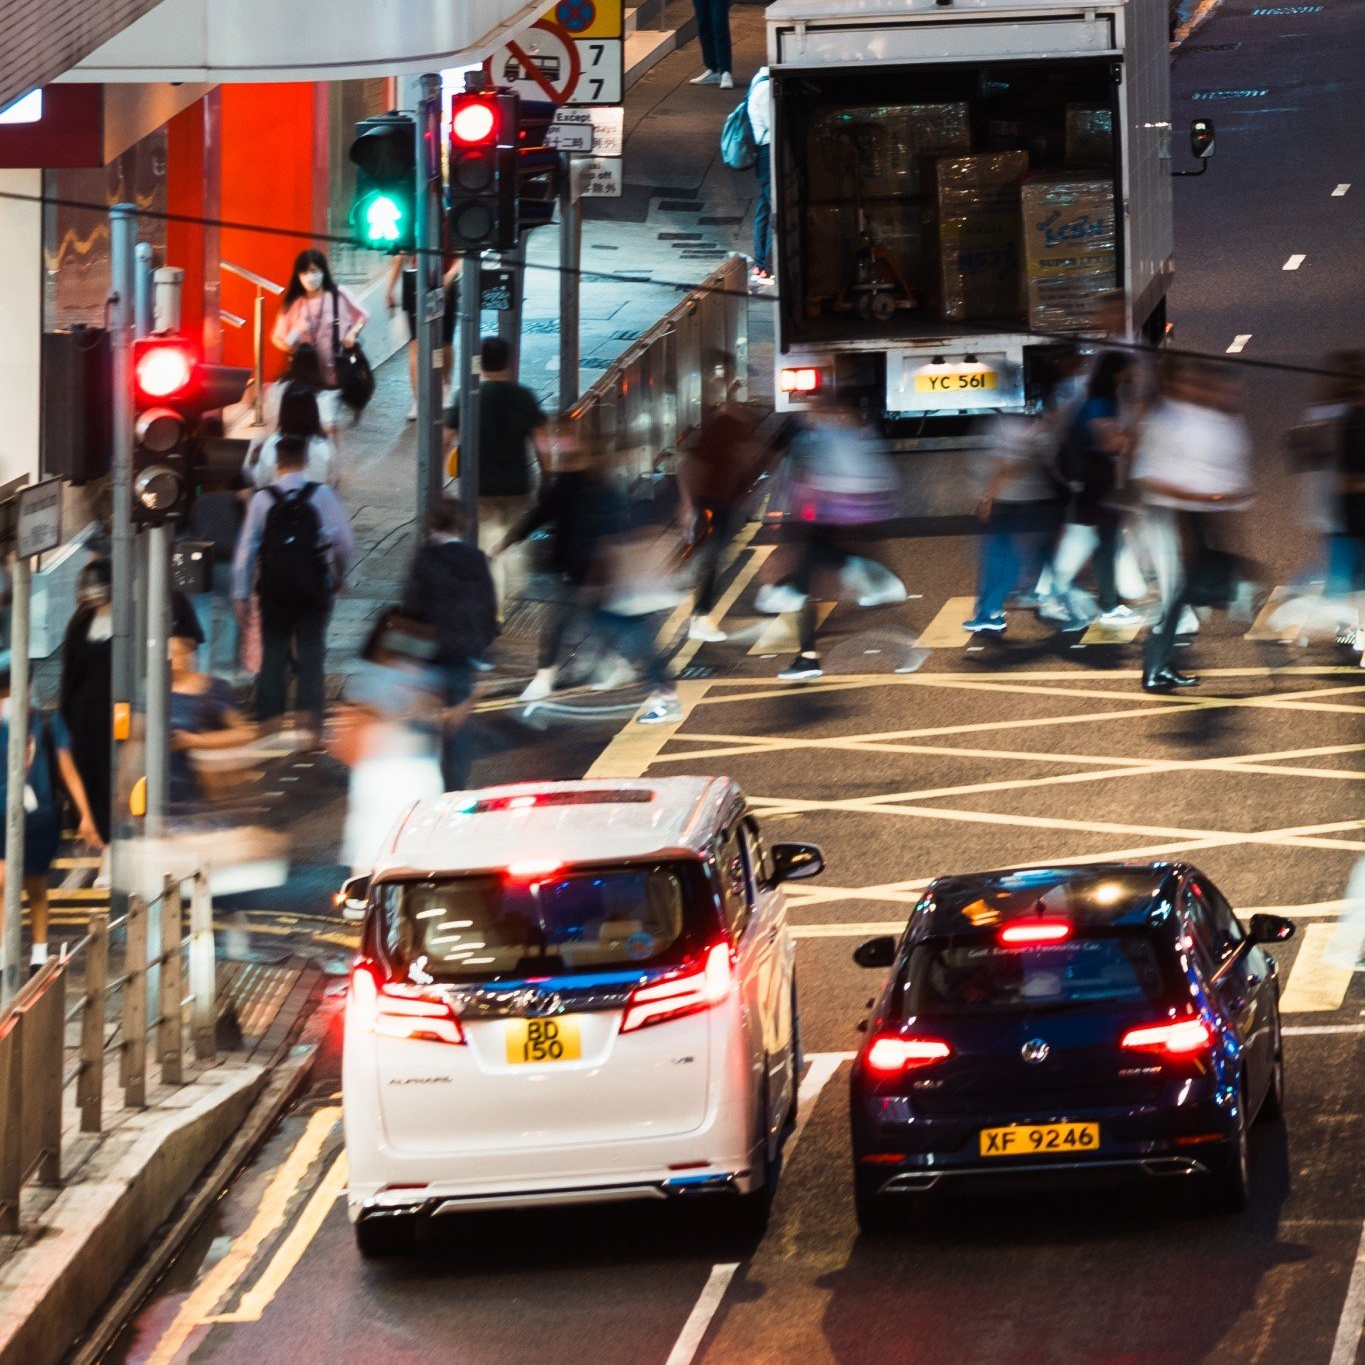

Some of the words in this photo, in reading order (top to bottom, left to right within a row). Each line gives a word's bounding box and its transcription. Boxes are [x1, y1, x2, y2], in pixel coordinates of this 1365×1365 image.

[589, 44, 604, 66] 7
[589, 78, 604, 100] 7
[929, 375, 952, 392] YC
[958, 373, 986, 390] 561
[528, 1019, 558, 1042] BD
[523, 1040, 564, 1062] 150
[986, 1131, 1017, 1153] XF
[1029, 1126, 1094, 1149] 9246
